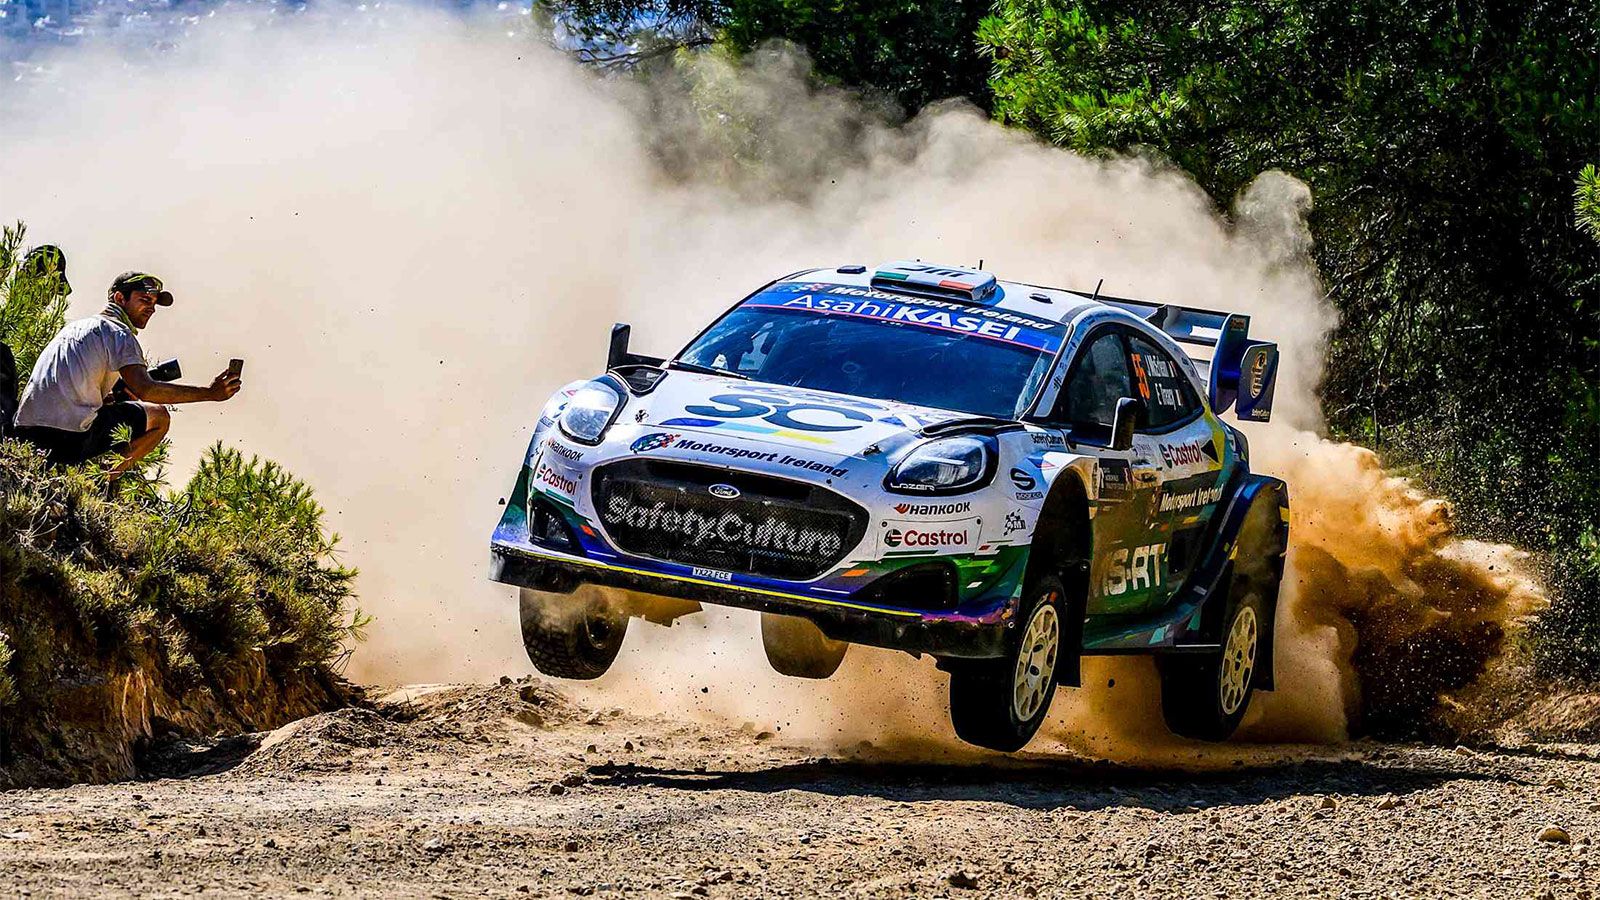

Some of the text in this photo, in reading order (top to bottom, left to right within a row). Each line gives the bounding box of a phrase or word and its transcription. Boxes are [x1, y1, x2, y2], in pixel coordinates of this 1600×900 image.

[782, 294, 1021, 340] AsahiKASEI
[828, 286, 961, 311] Motorsport
[964, 303, 1055, 330] Ireland
[684, 393, 874, 432] SC
[674, 439, 849, 478] Motorsport Ireland
[1169, 440, 1203, 465] Castrol
[542, 468, 578, 495] Castrol
[1159, 484, 1224, 513] Motorsport Ireland
[904, 529, 968, 545] Castrol
